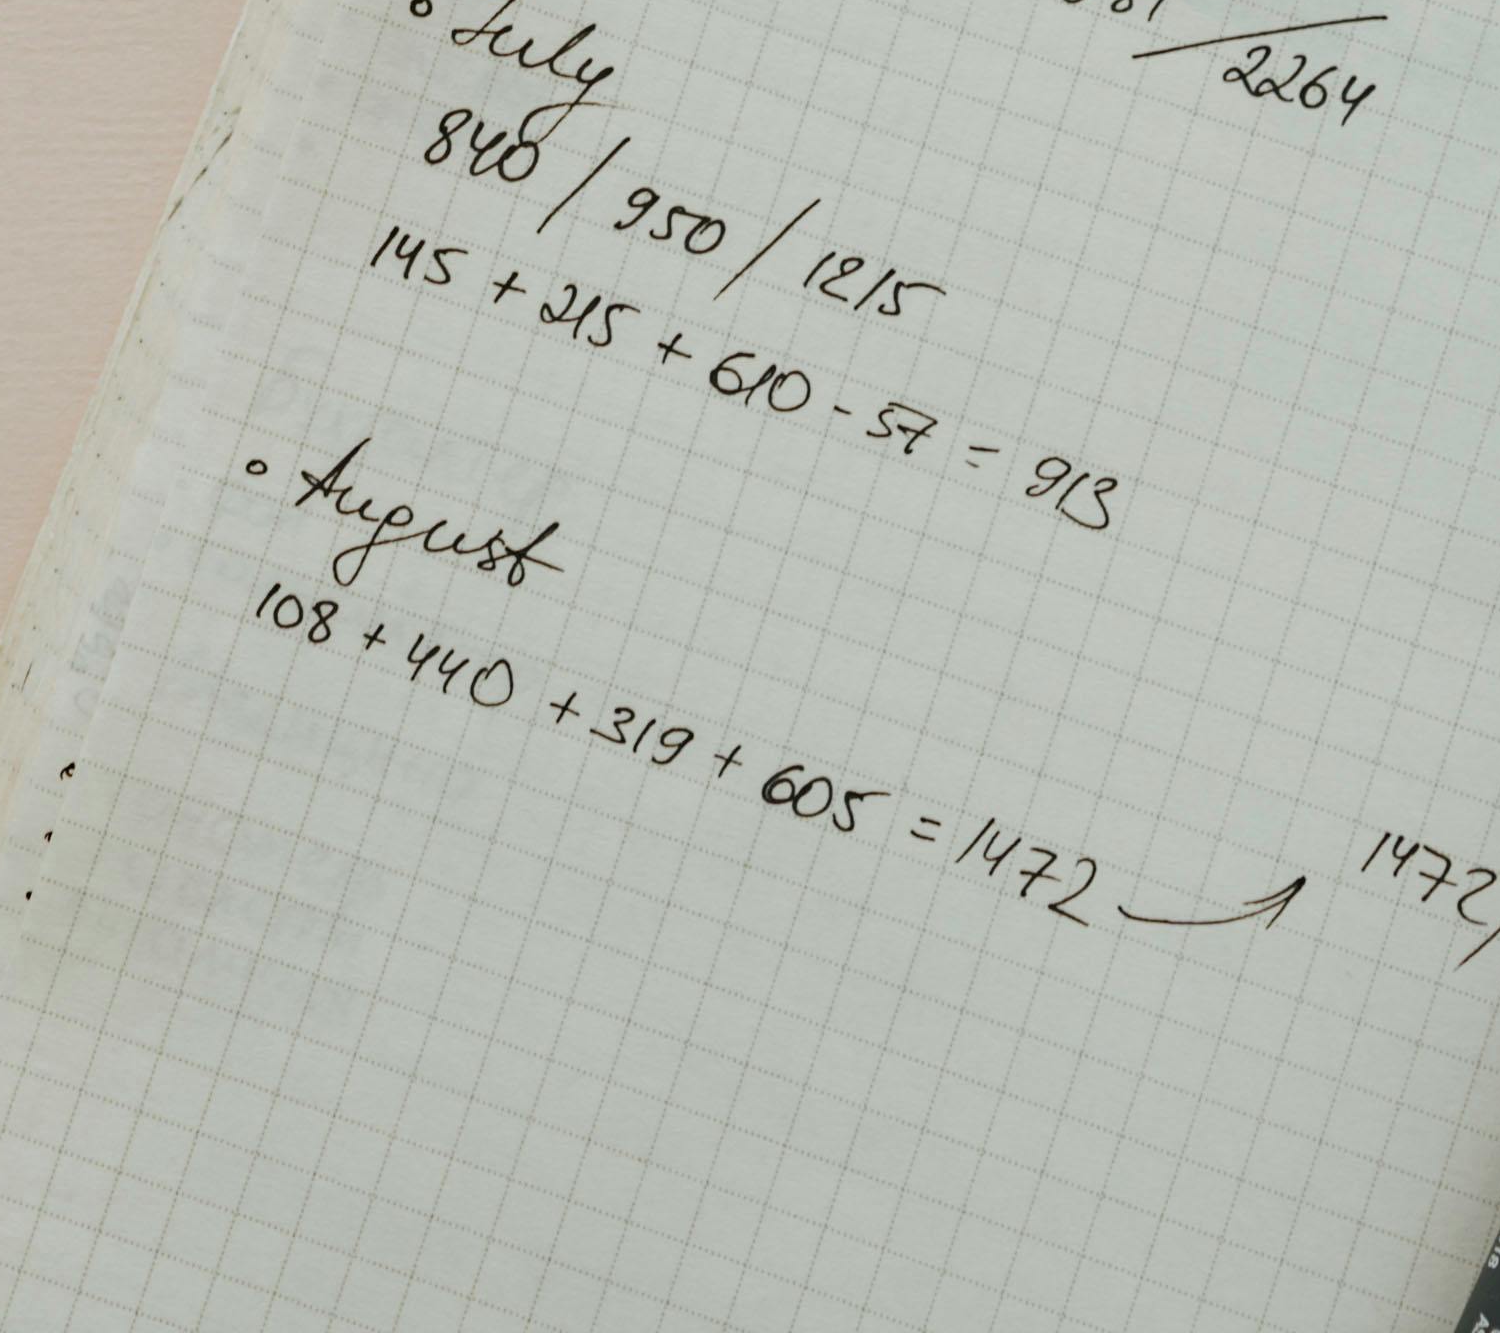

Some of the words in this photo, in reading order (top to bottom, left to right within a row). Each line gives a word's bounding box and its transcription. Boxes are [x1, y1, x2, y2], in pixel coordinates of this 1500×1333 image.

[1221, 41, 1378, 128] 2264
[423, 108, 541, 182] 840
[613, 187, 726, 255] 950
[802, 251, 947, 316] 1215
[369, 225, 469, 285] 145
[539, 283, 641, 348] 215
[709, 351, 811, 413] 610
[866, 401, 938, 455] 57
[1022, 453, 1122, 532] 913
[294, 437, 563, 588] August
[255, 582, 339, 644] 108
[407, 633, 514, 708] 440
[589, 706, 695, 766] 319
[761, 764, 891, 833] 605
[955, 817, 1097, 927] 1472
